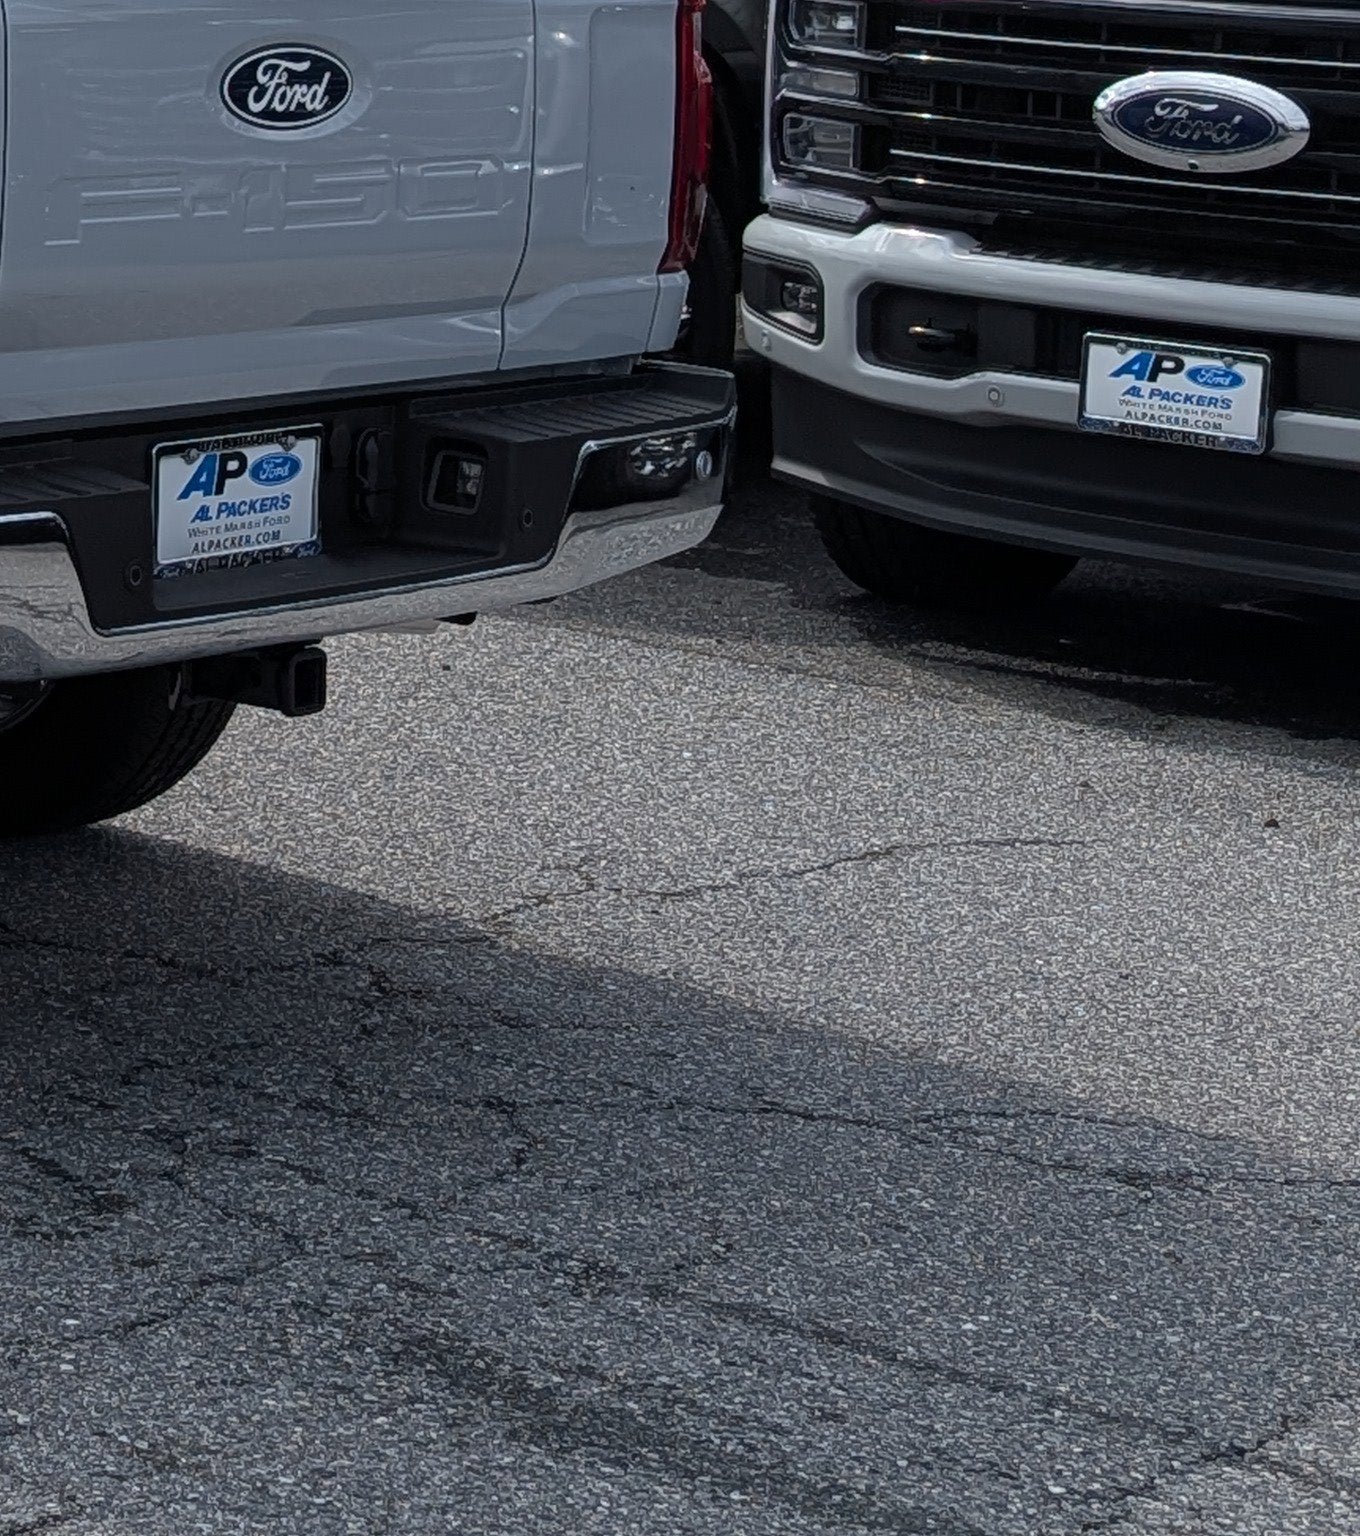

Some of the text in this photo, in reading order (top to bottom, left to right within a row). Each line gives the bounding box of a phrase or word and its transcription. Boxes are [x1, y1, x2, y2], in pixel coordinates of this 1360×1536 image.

[247, 58, 331, 113] Ford
[1144, 97, 1243, 144] Ford
[43, 154, 506, 246] F-150
[1108, 351, 1186, 383] AP
[1195, 369, 1233, 386] Ford
[1121, 385, 1234, 410] AL PACKER'S
[1125, 410, 1223, 431] ALPACKER.COM
[176, 450, 249, 501] AP
[258, 457, 292, 480] Ford
[190, 492, 292, 524] AL PACKER'S
[191, 529, 281, 555] ALPACKER.COM
